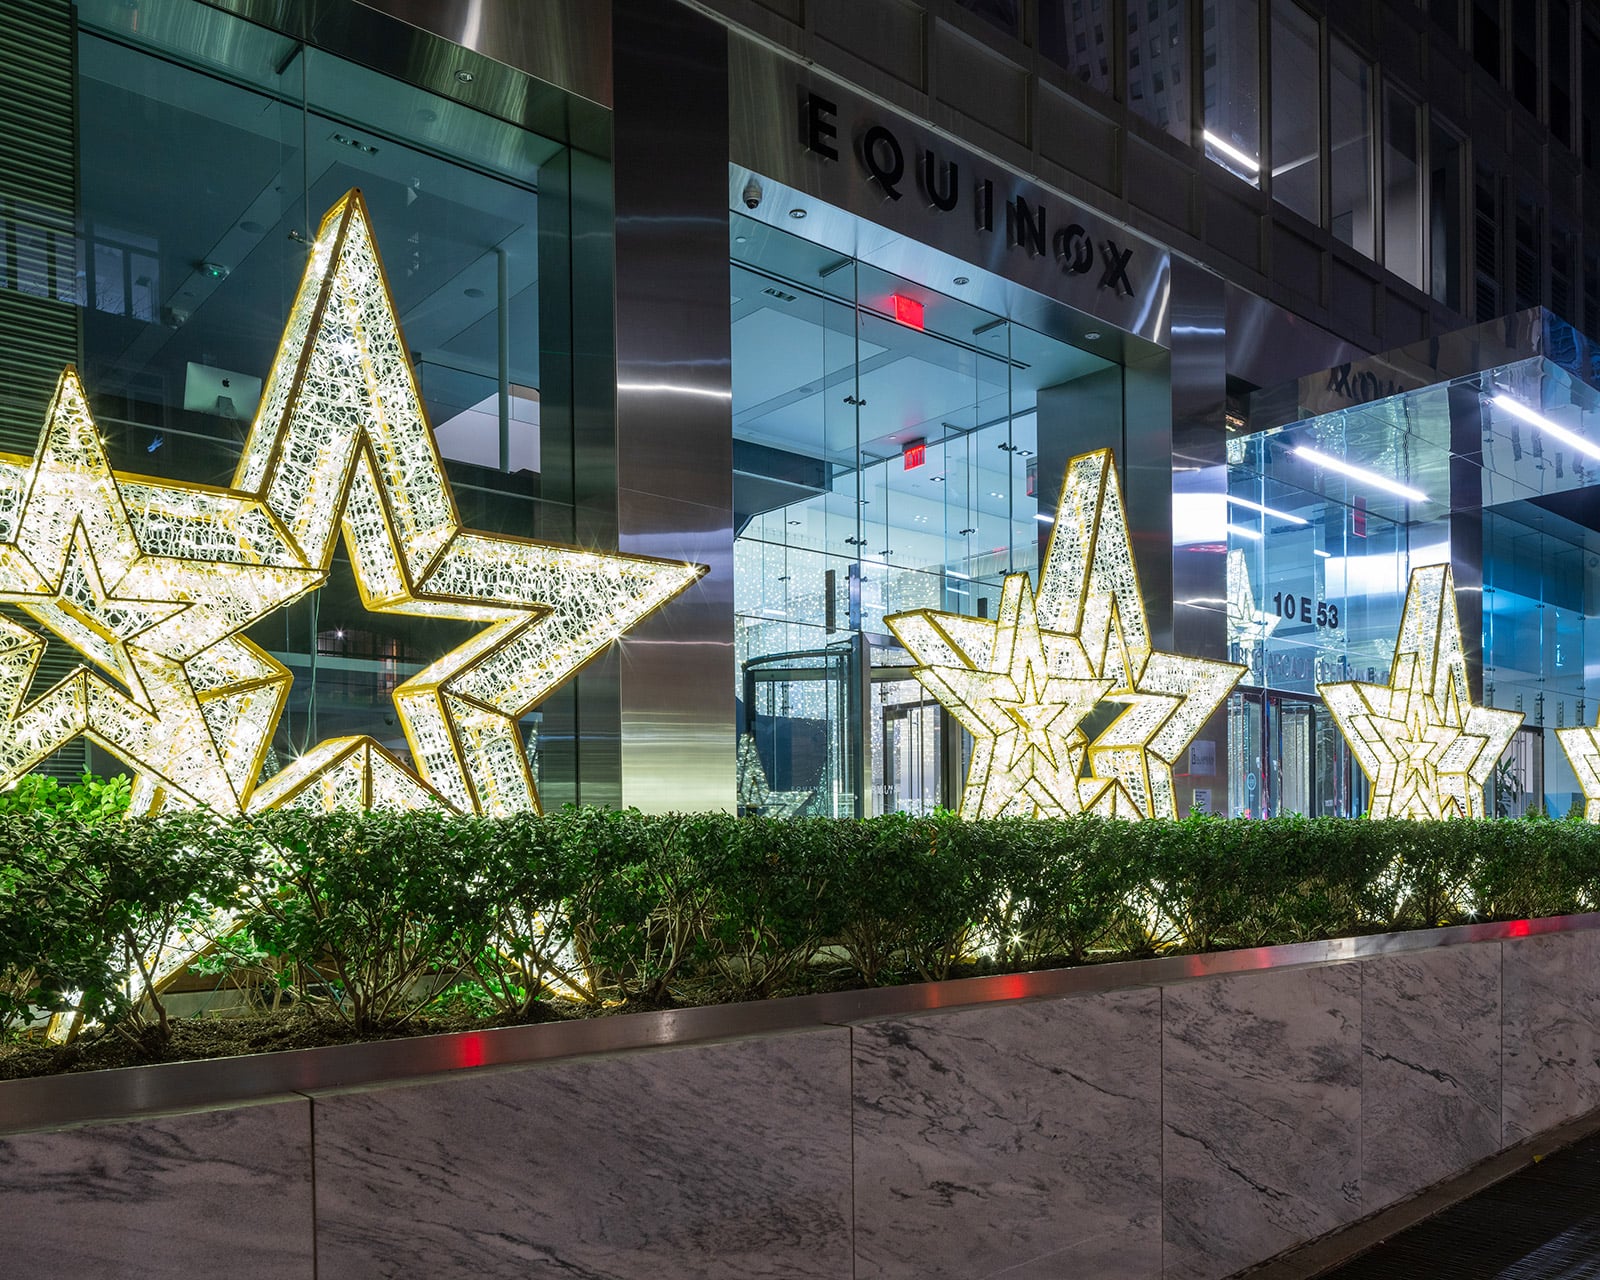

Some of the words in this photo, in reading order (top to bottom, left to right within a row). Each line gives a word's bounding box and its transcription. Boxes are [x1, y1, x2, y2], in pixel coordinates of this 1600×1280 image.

[807, 92, 1134, 297] EQUINOX
[1273, 592, 1296, 619] 10
[1301, 597, 1312, 624] E
[1316, 601, 1338, 629] 53
